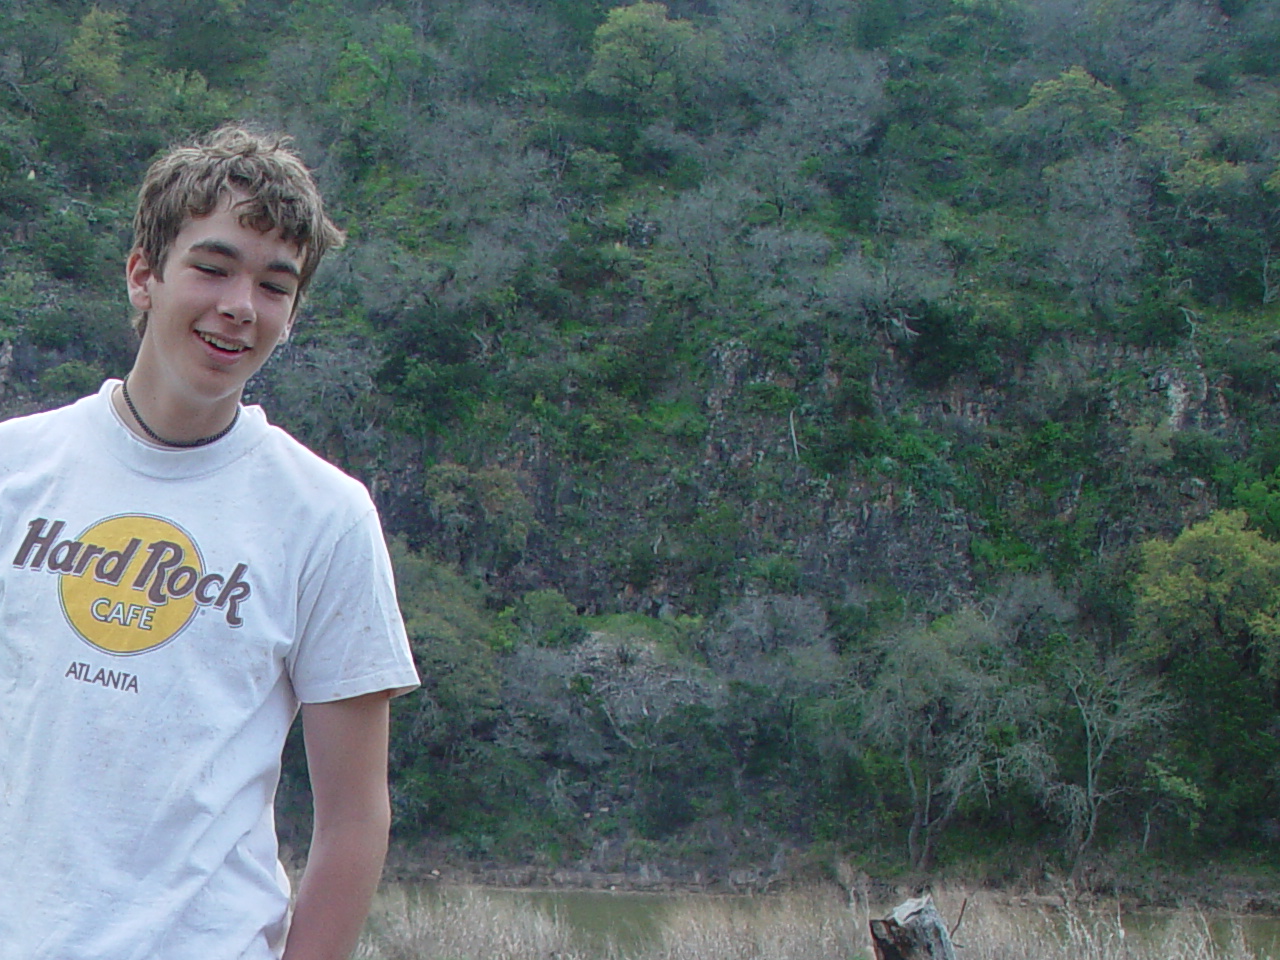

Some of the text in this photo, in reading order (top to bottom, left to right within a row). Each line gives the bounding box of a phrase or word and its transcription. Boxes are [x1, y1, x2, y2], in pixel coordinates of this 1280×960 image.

[13, 517, 252, 627] Hard Rock
[91, 597, 156, 630] CAFE
[65, 661, 139, 693] ATLANTA
